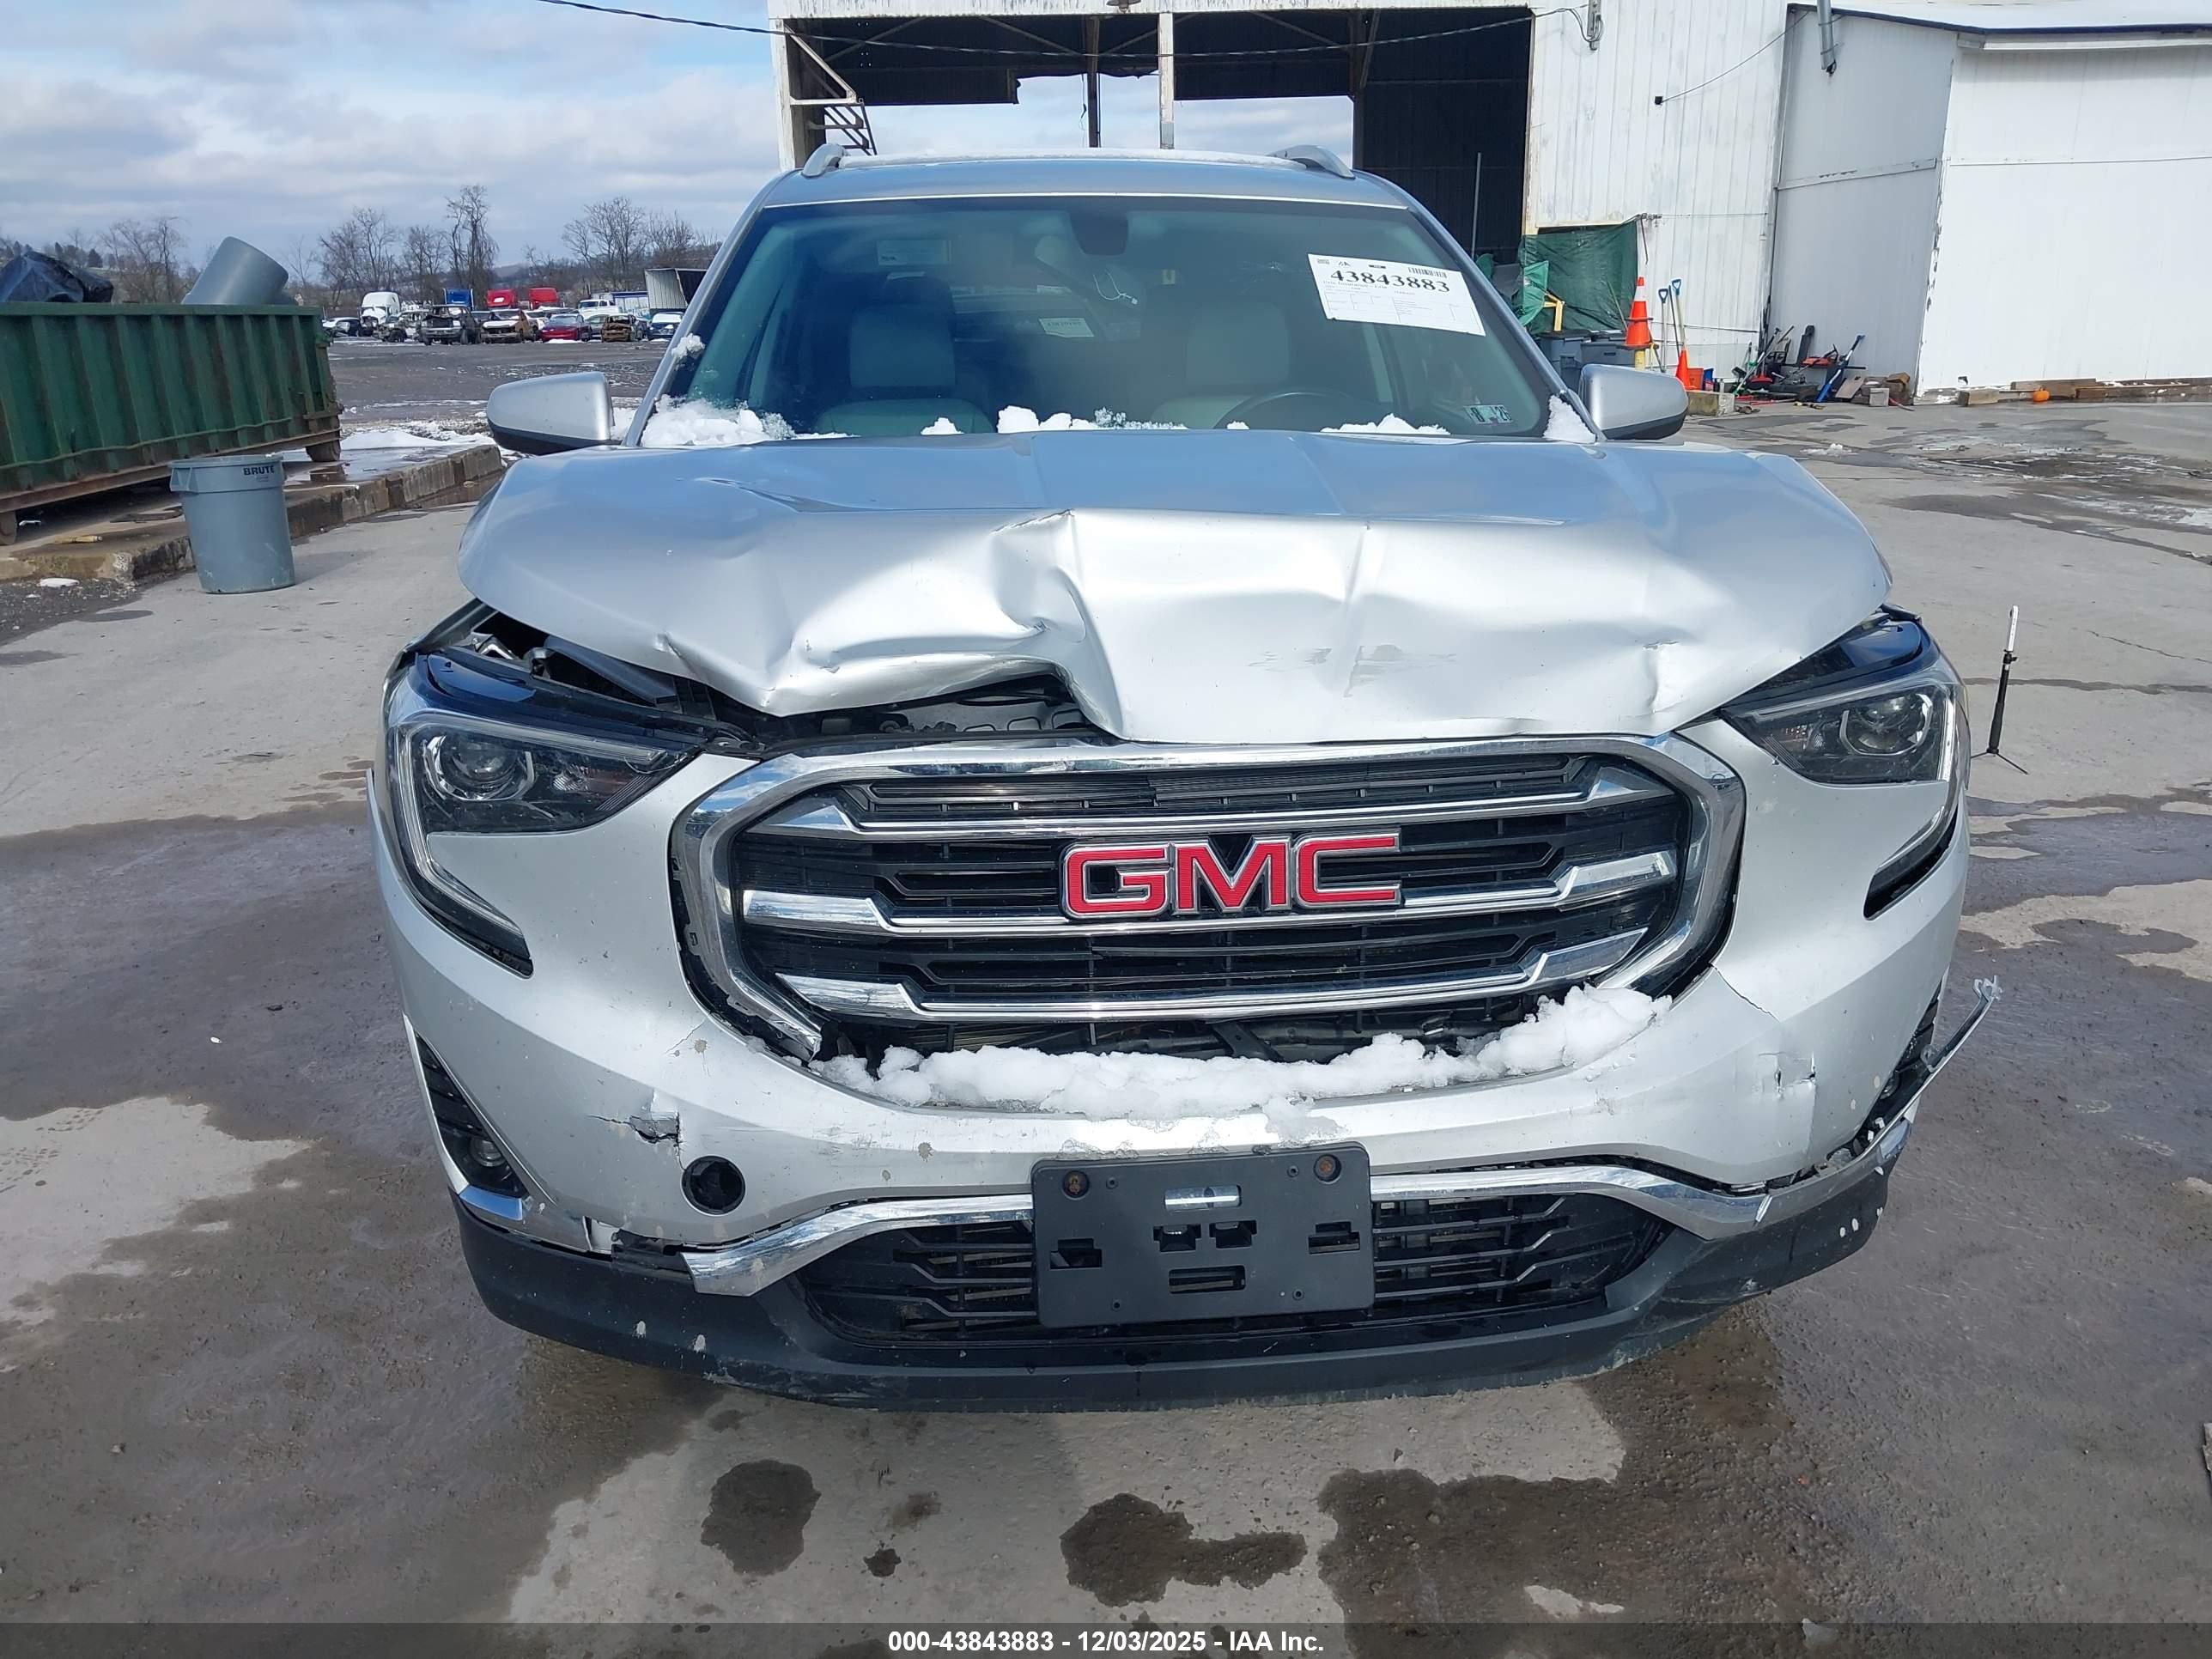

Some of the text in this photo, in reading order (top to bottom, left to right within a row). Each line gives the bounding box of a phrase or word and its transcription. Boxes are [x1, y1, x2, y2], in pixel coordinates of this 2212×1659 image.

[1331, 270, 1449, 293] 43843883
[243, 465, 275, 476] BRUTE
[1062, 830, 1402, 920] GMC
